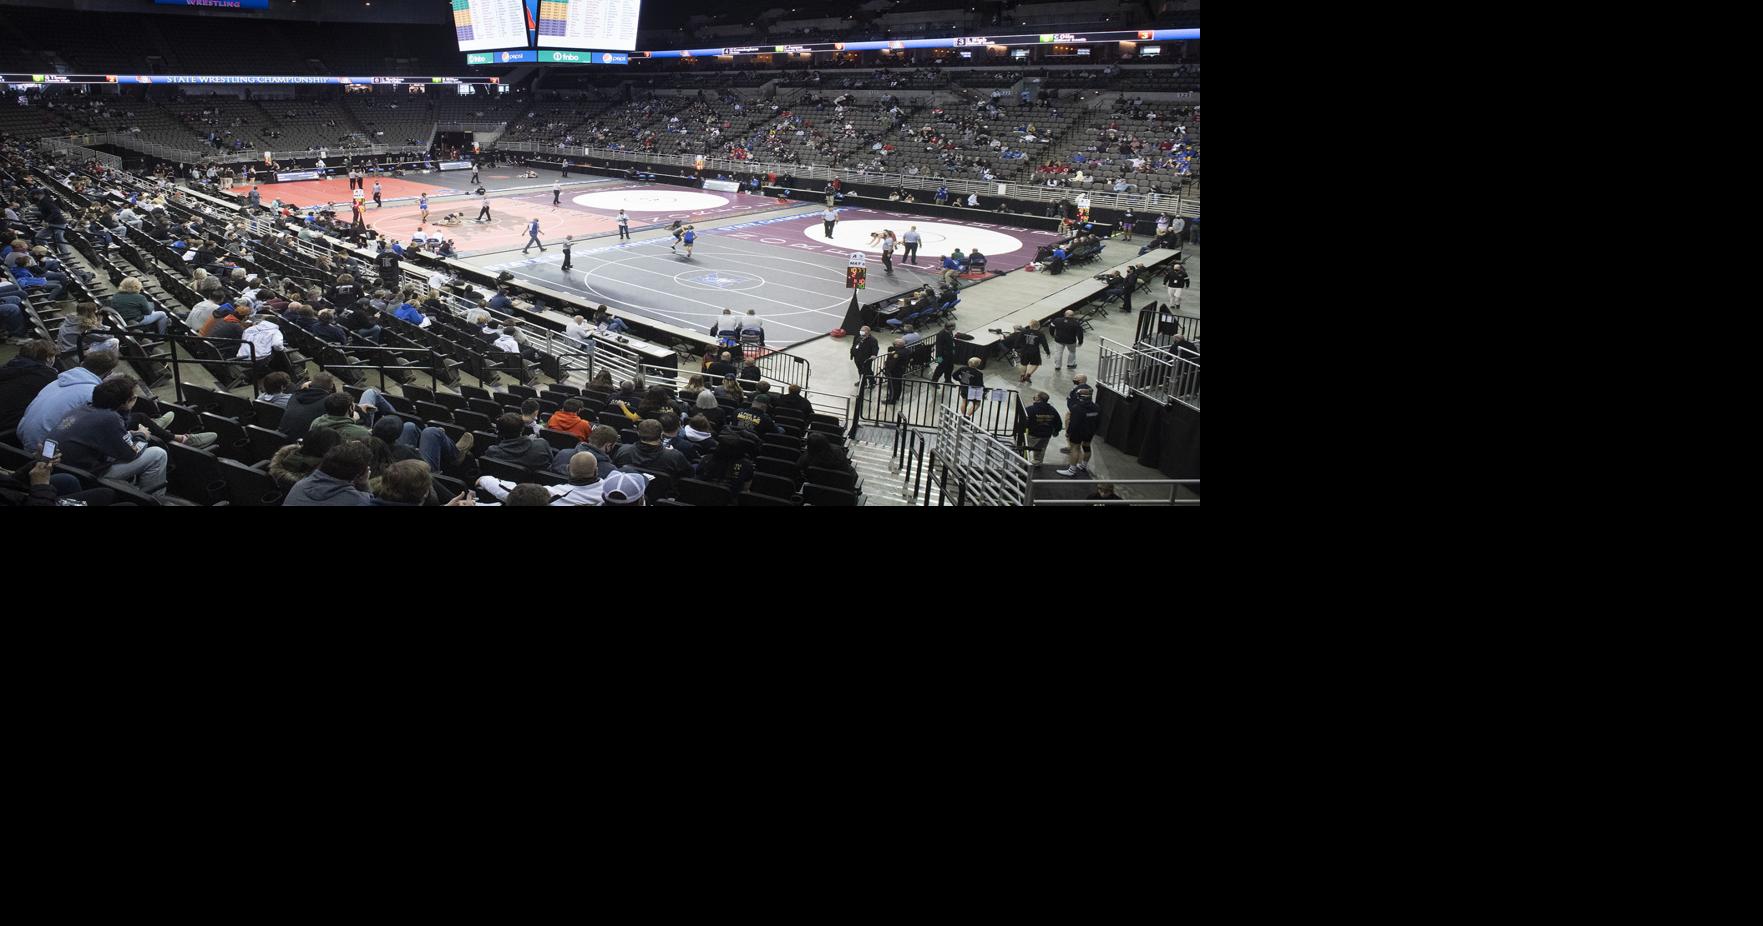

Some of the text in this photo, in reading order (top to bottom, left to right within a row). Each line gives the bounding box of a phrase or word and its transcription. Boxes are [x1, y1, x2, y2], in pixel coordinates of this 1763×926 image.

[167, 75, 329, 84] STATE WRESTLING CHAMPIONSHIP
